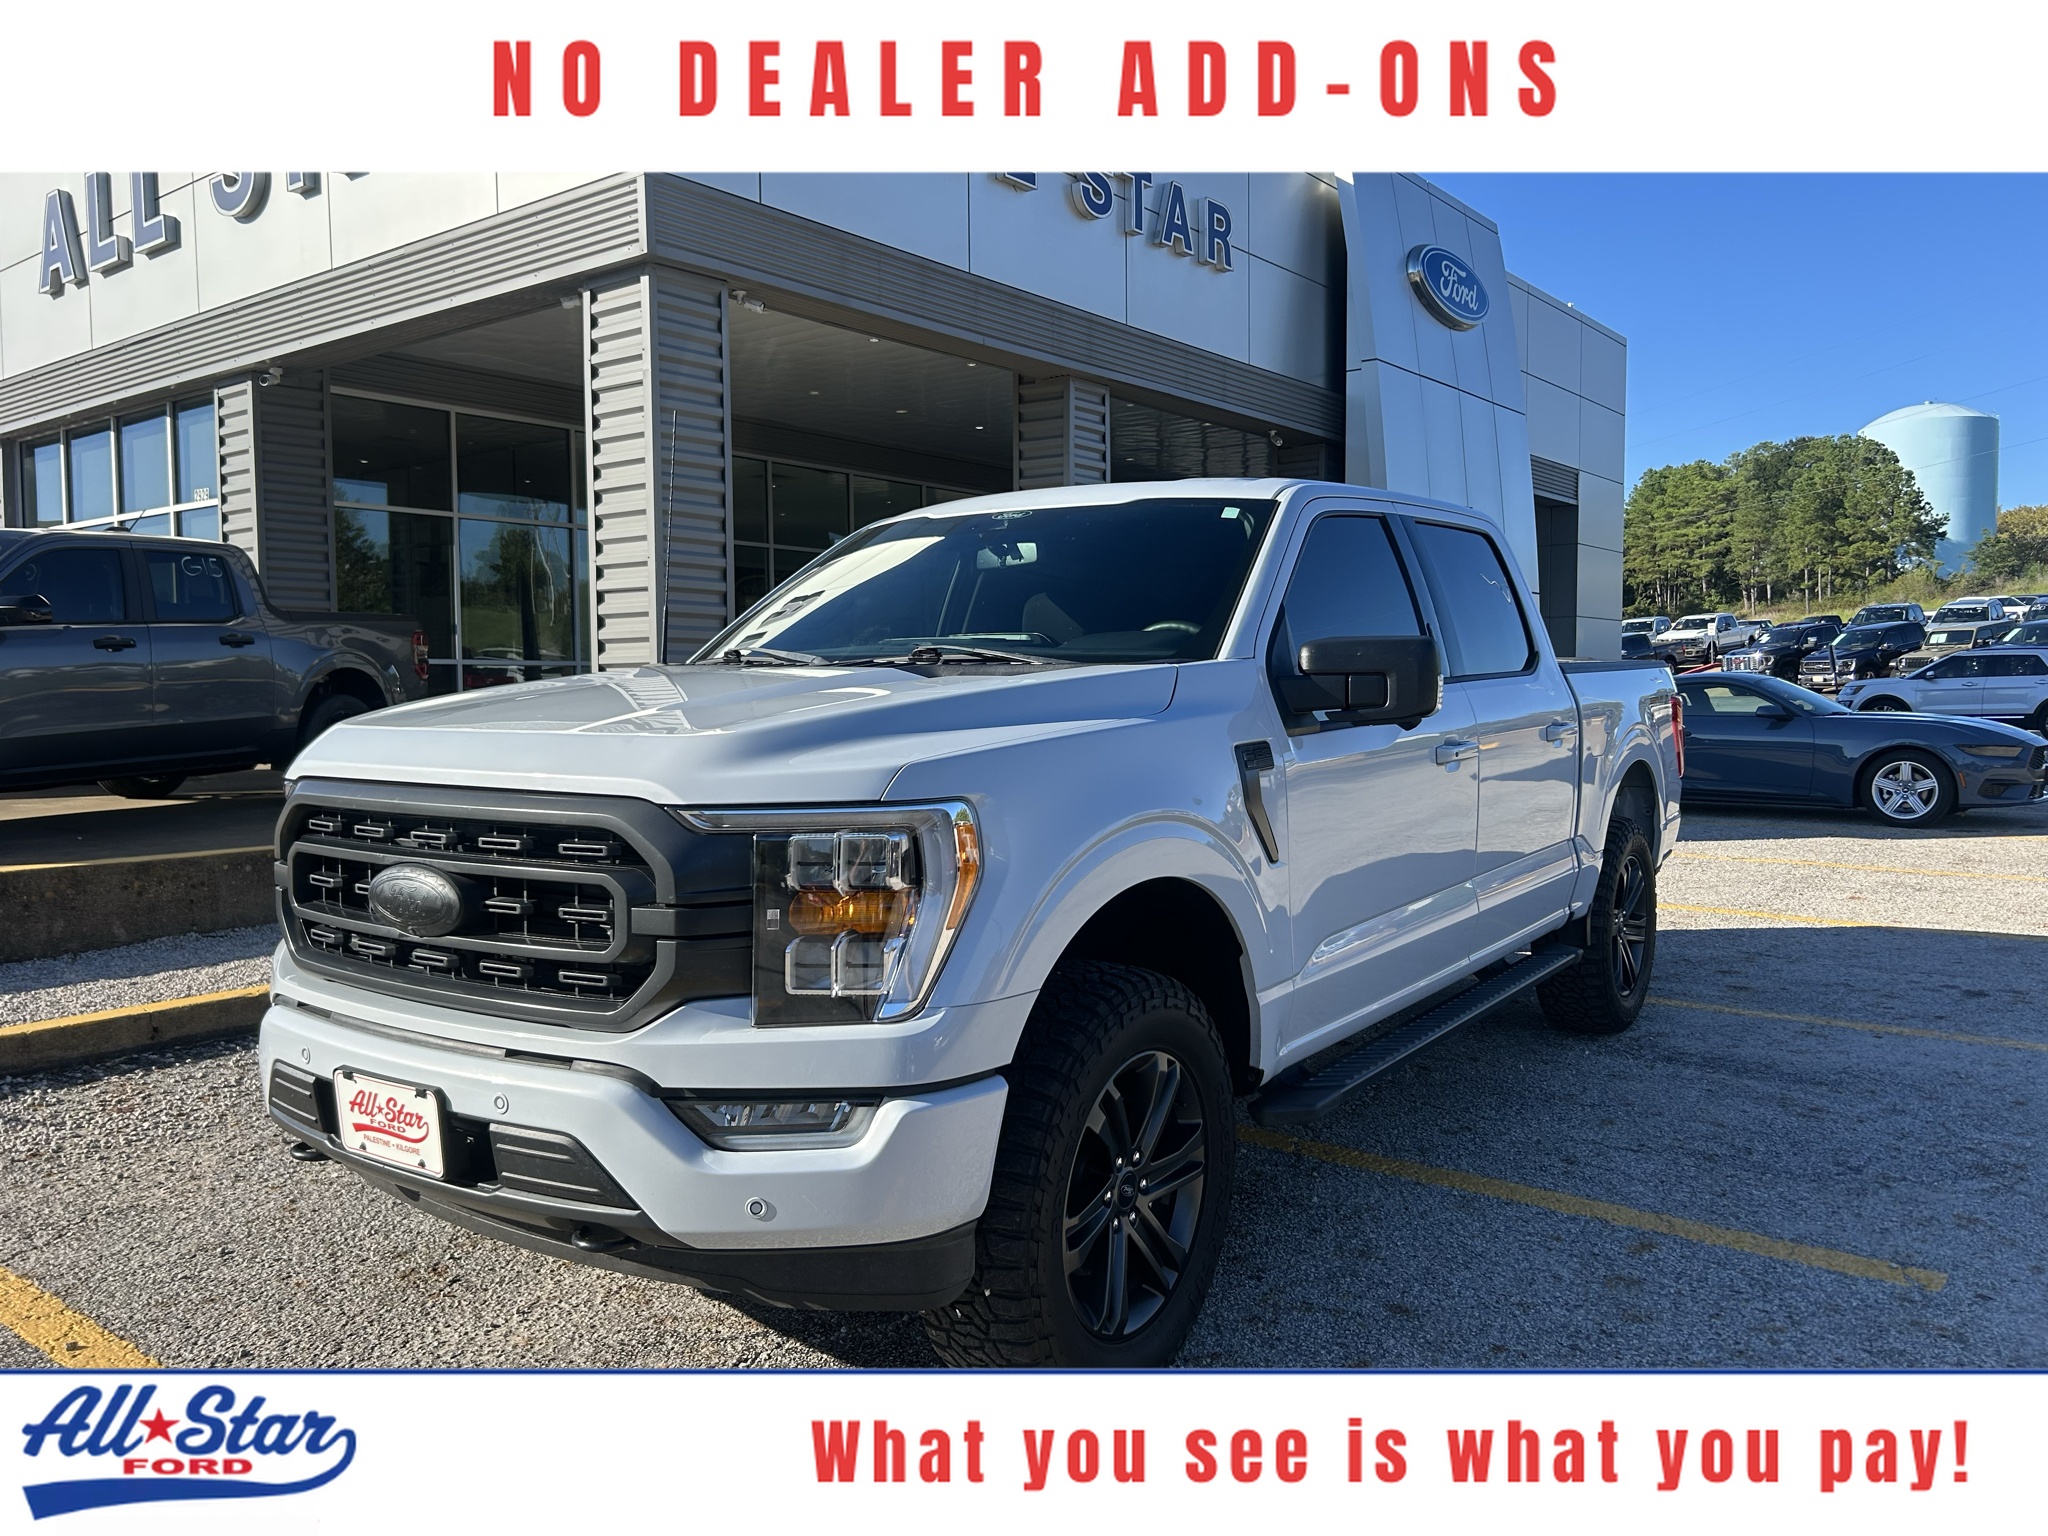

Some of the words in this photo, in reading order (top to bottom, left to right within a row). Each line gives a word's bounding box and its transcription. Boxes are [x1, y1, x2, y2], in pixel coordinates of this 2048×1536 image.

[39, 172, 182, 294] ALL
[1072, 172, 1234, 273] STAR
[1440, 260, 1479, 311] Ford
[349, 1089, 378, 1118] All
[384, 1096, 426, 1130] Star
[370, 1118, 406, 1134] FORD
[363, 1133, 391, 1148] PALESTINE
[396, 1142, 421, 1156] KILGORE
